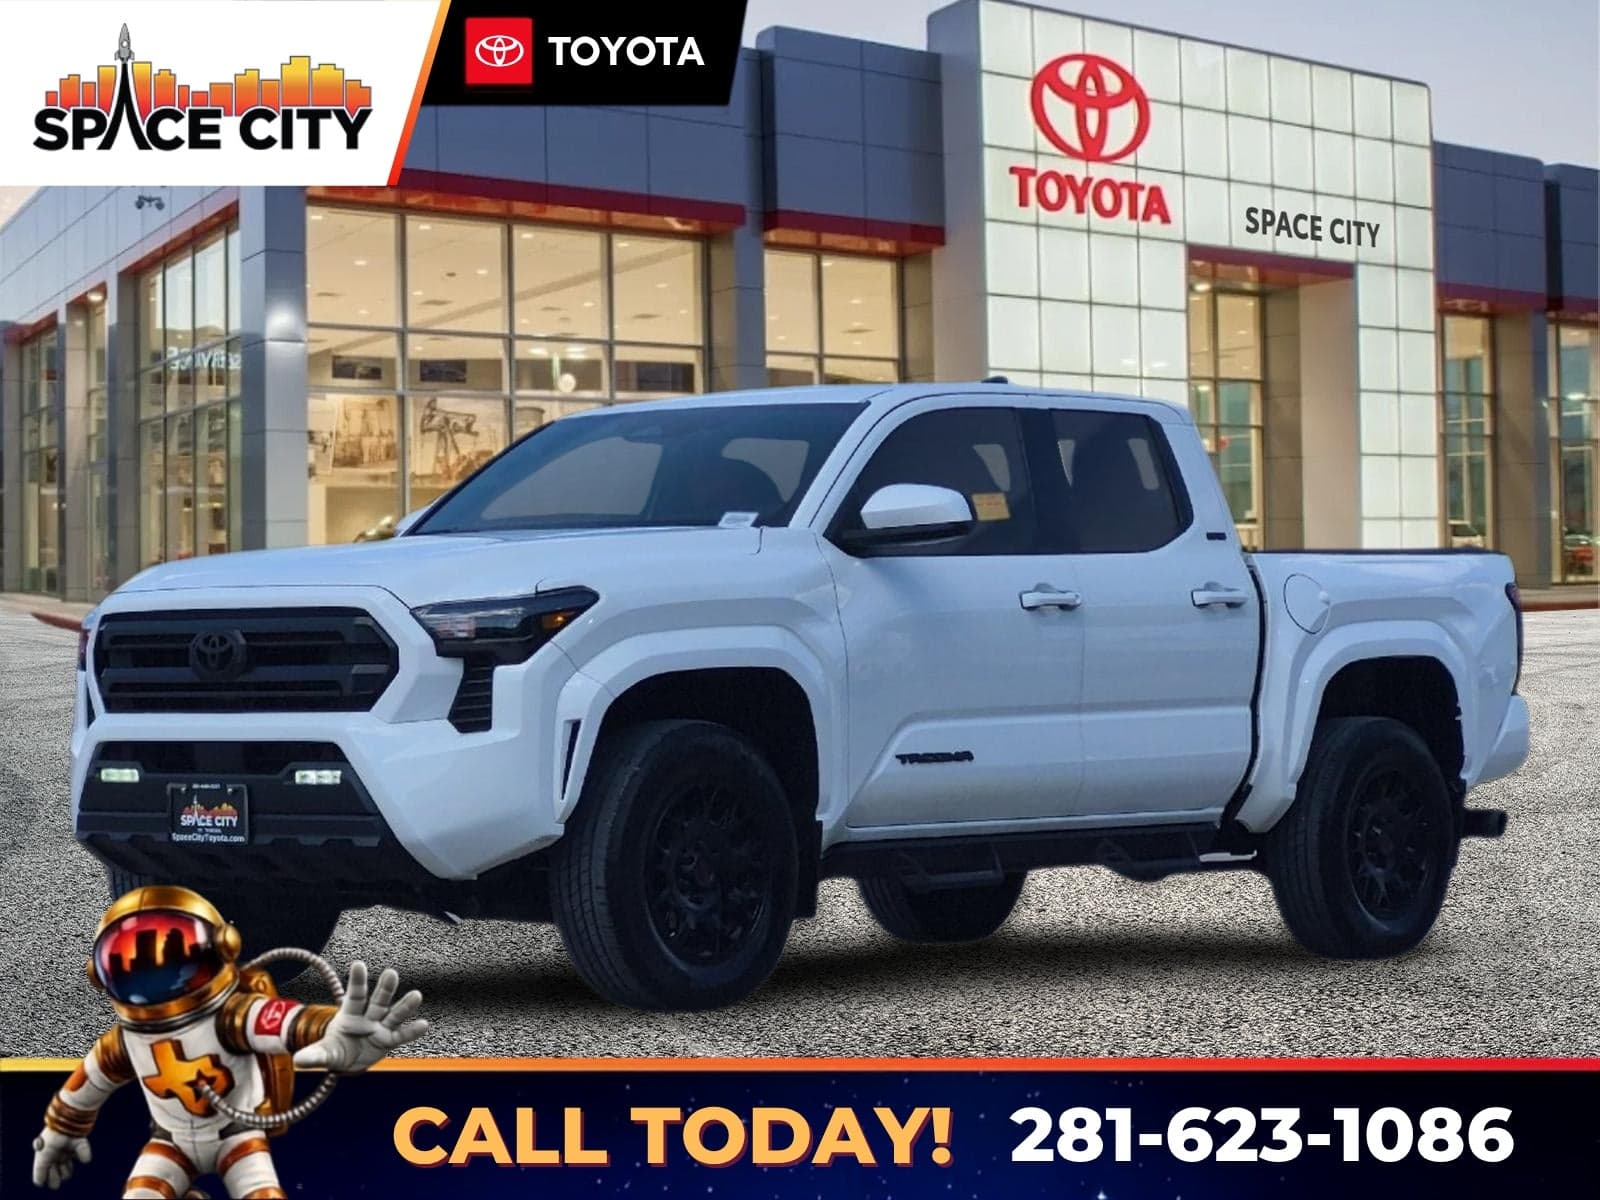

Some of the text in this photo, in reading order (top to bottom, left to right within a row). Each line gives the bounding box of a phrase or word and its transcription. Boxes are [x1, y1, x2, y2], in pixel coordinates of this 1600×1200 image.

[1009, 165, 1171, 225] TOYOTA
[1245, 206, 1381, 248] SPACE CITY
[180, 814, 239, 828] SPACE CITY
